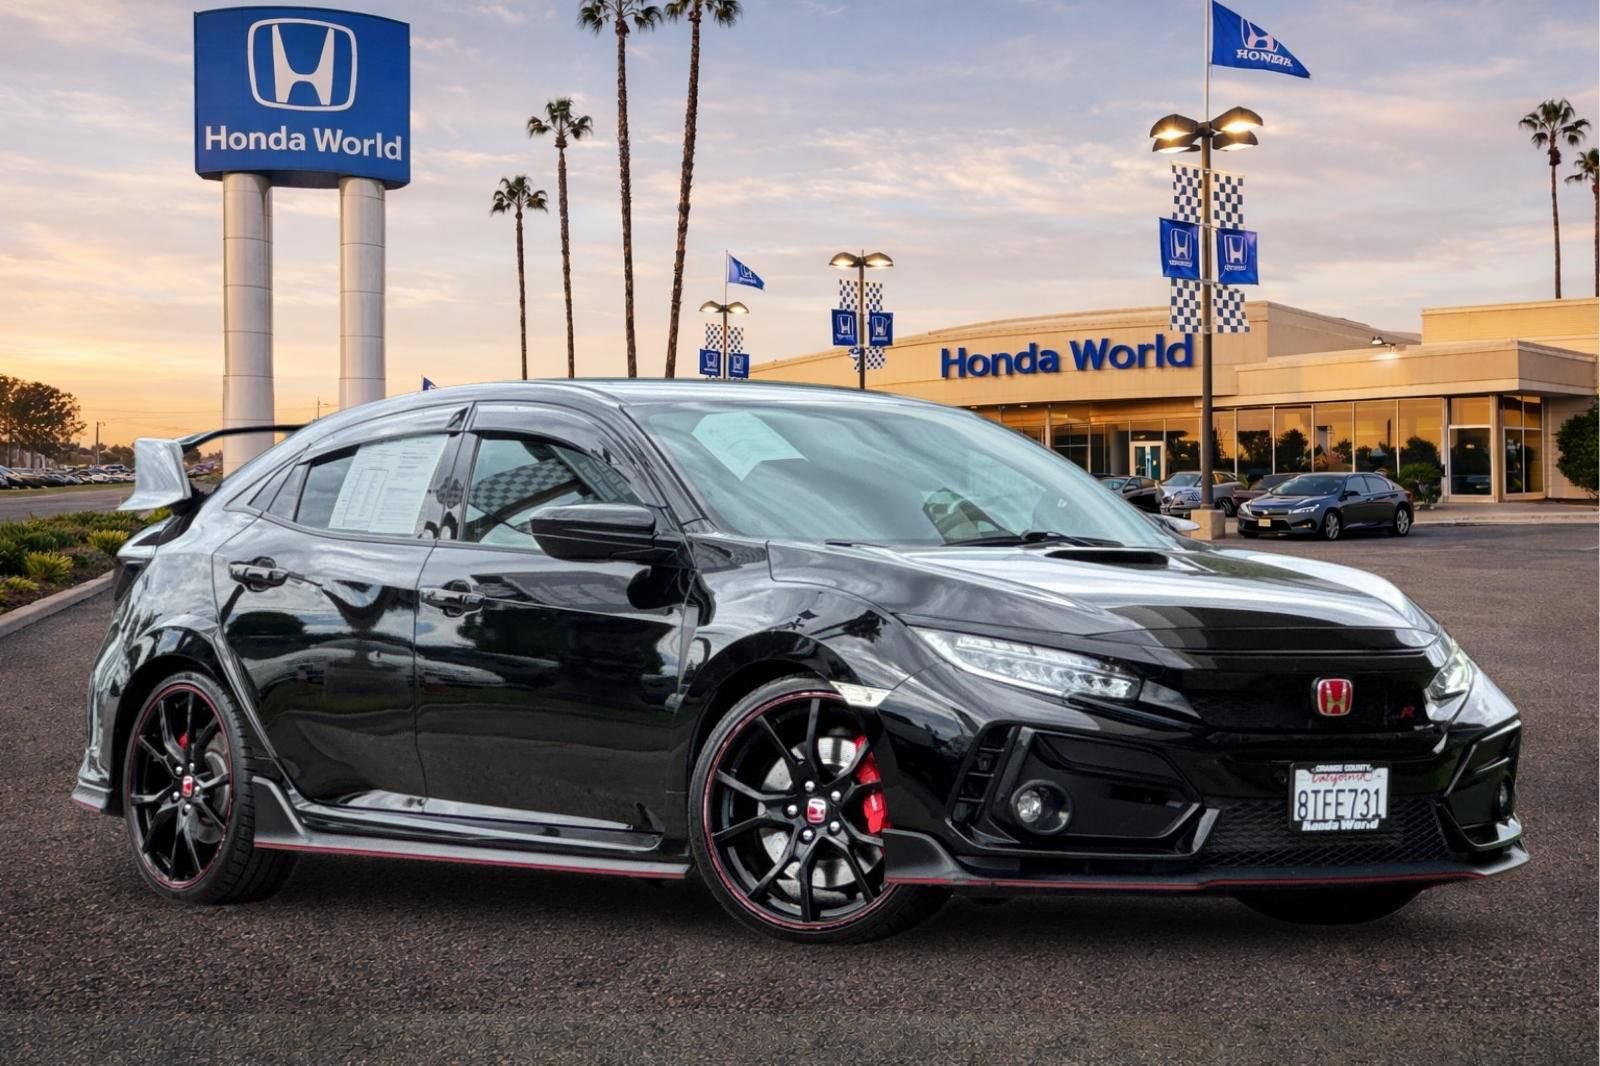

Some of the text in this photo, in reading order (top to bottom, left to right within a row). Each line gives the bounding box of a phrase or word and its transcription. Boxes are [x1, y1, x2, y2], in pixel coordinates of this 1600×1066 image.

[205, 125, 402, 161] Honda World
[941, 333, 1194, 378] Honda World
[1315, 763, 1371, 772] ORANGE COUNTY
[1312, 773, 1371, 787] California
[1297, 788, 1382, 820] 8TFE731
[1302, 820, 1340, 831] Honda
